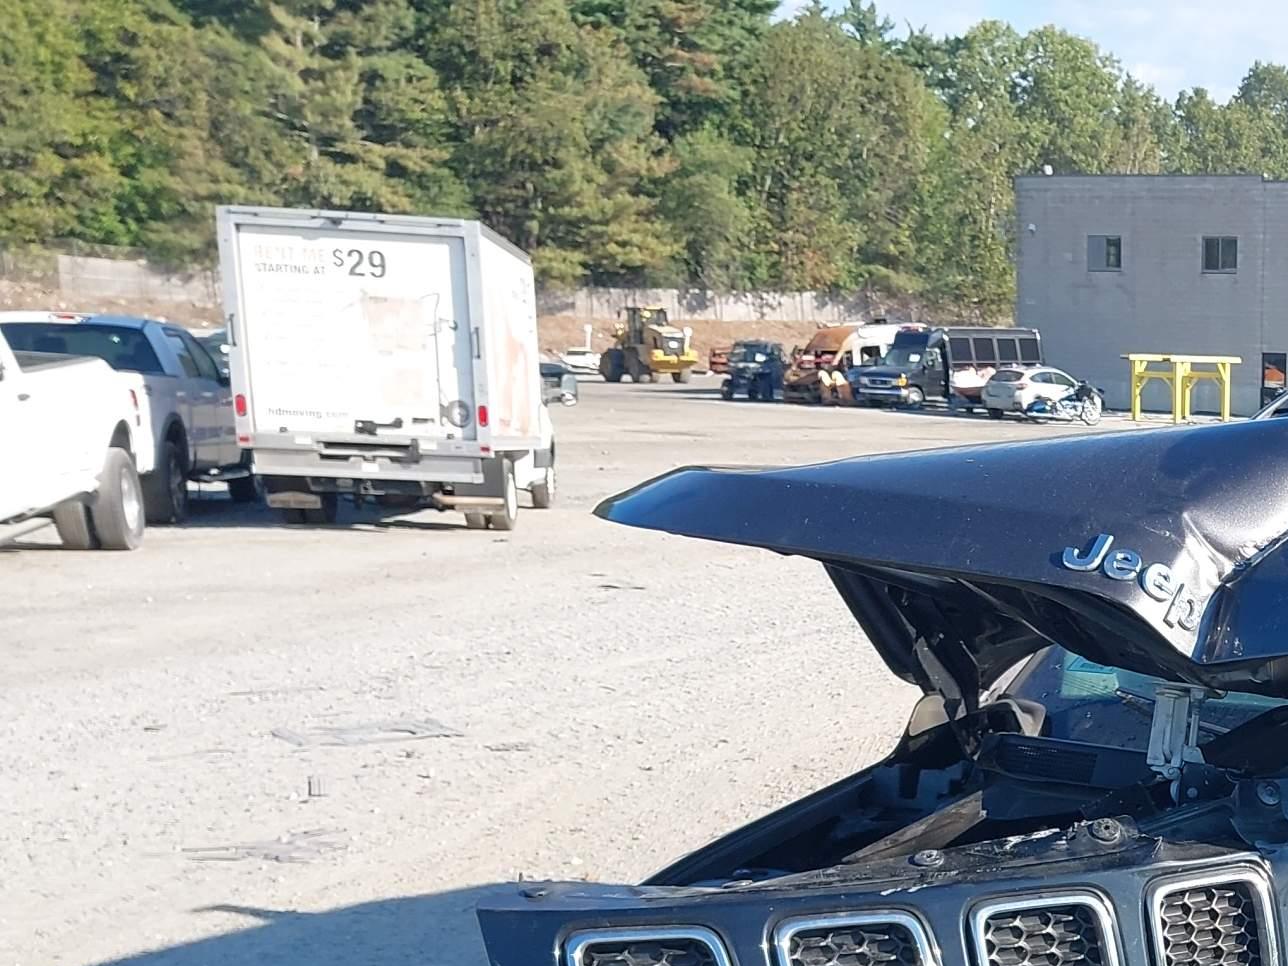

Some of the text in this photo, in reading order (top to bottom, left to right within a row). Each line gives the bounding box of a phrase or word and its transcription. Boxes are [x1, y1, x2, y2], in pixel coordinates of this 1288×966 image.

[255, 262, 326, 275] STARTING AT
[332, 248, 387, 278] $29
[1062, 533, 1201, 632] Jeep
